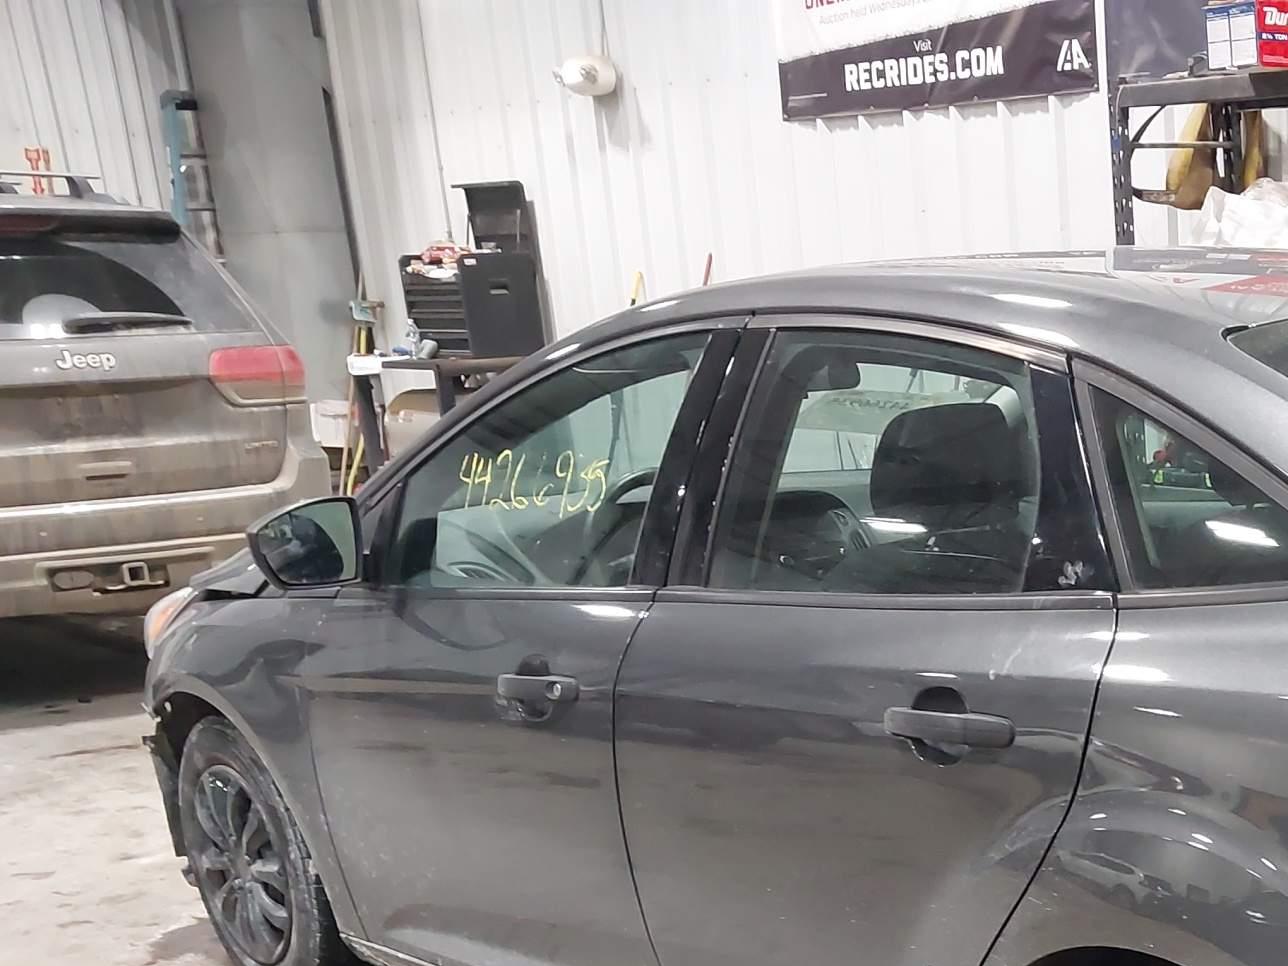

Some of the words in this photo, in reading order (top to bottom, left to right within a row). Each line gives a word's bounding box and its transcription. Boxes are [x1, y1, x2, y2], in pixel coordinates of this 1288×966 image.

[913, 38, 932, 52] Visit
[844, 46, 1004, 91] RECRIDES.COM
[55, 349, 117, 371] Jeep
